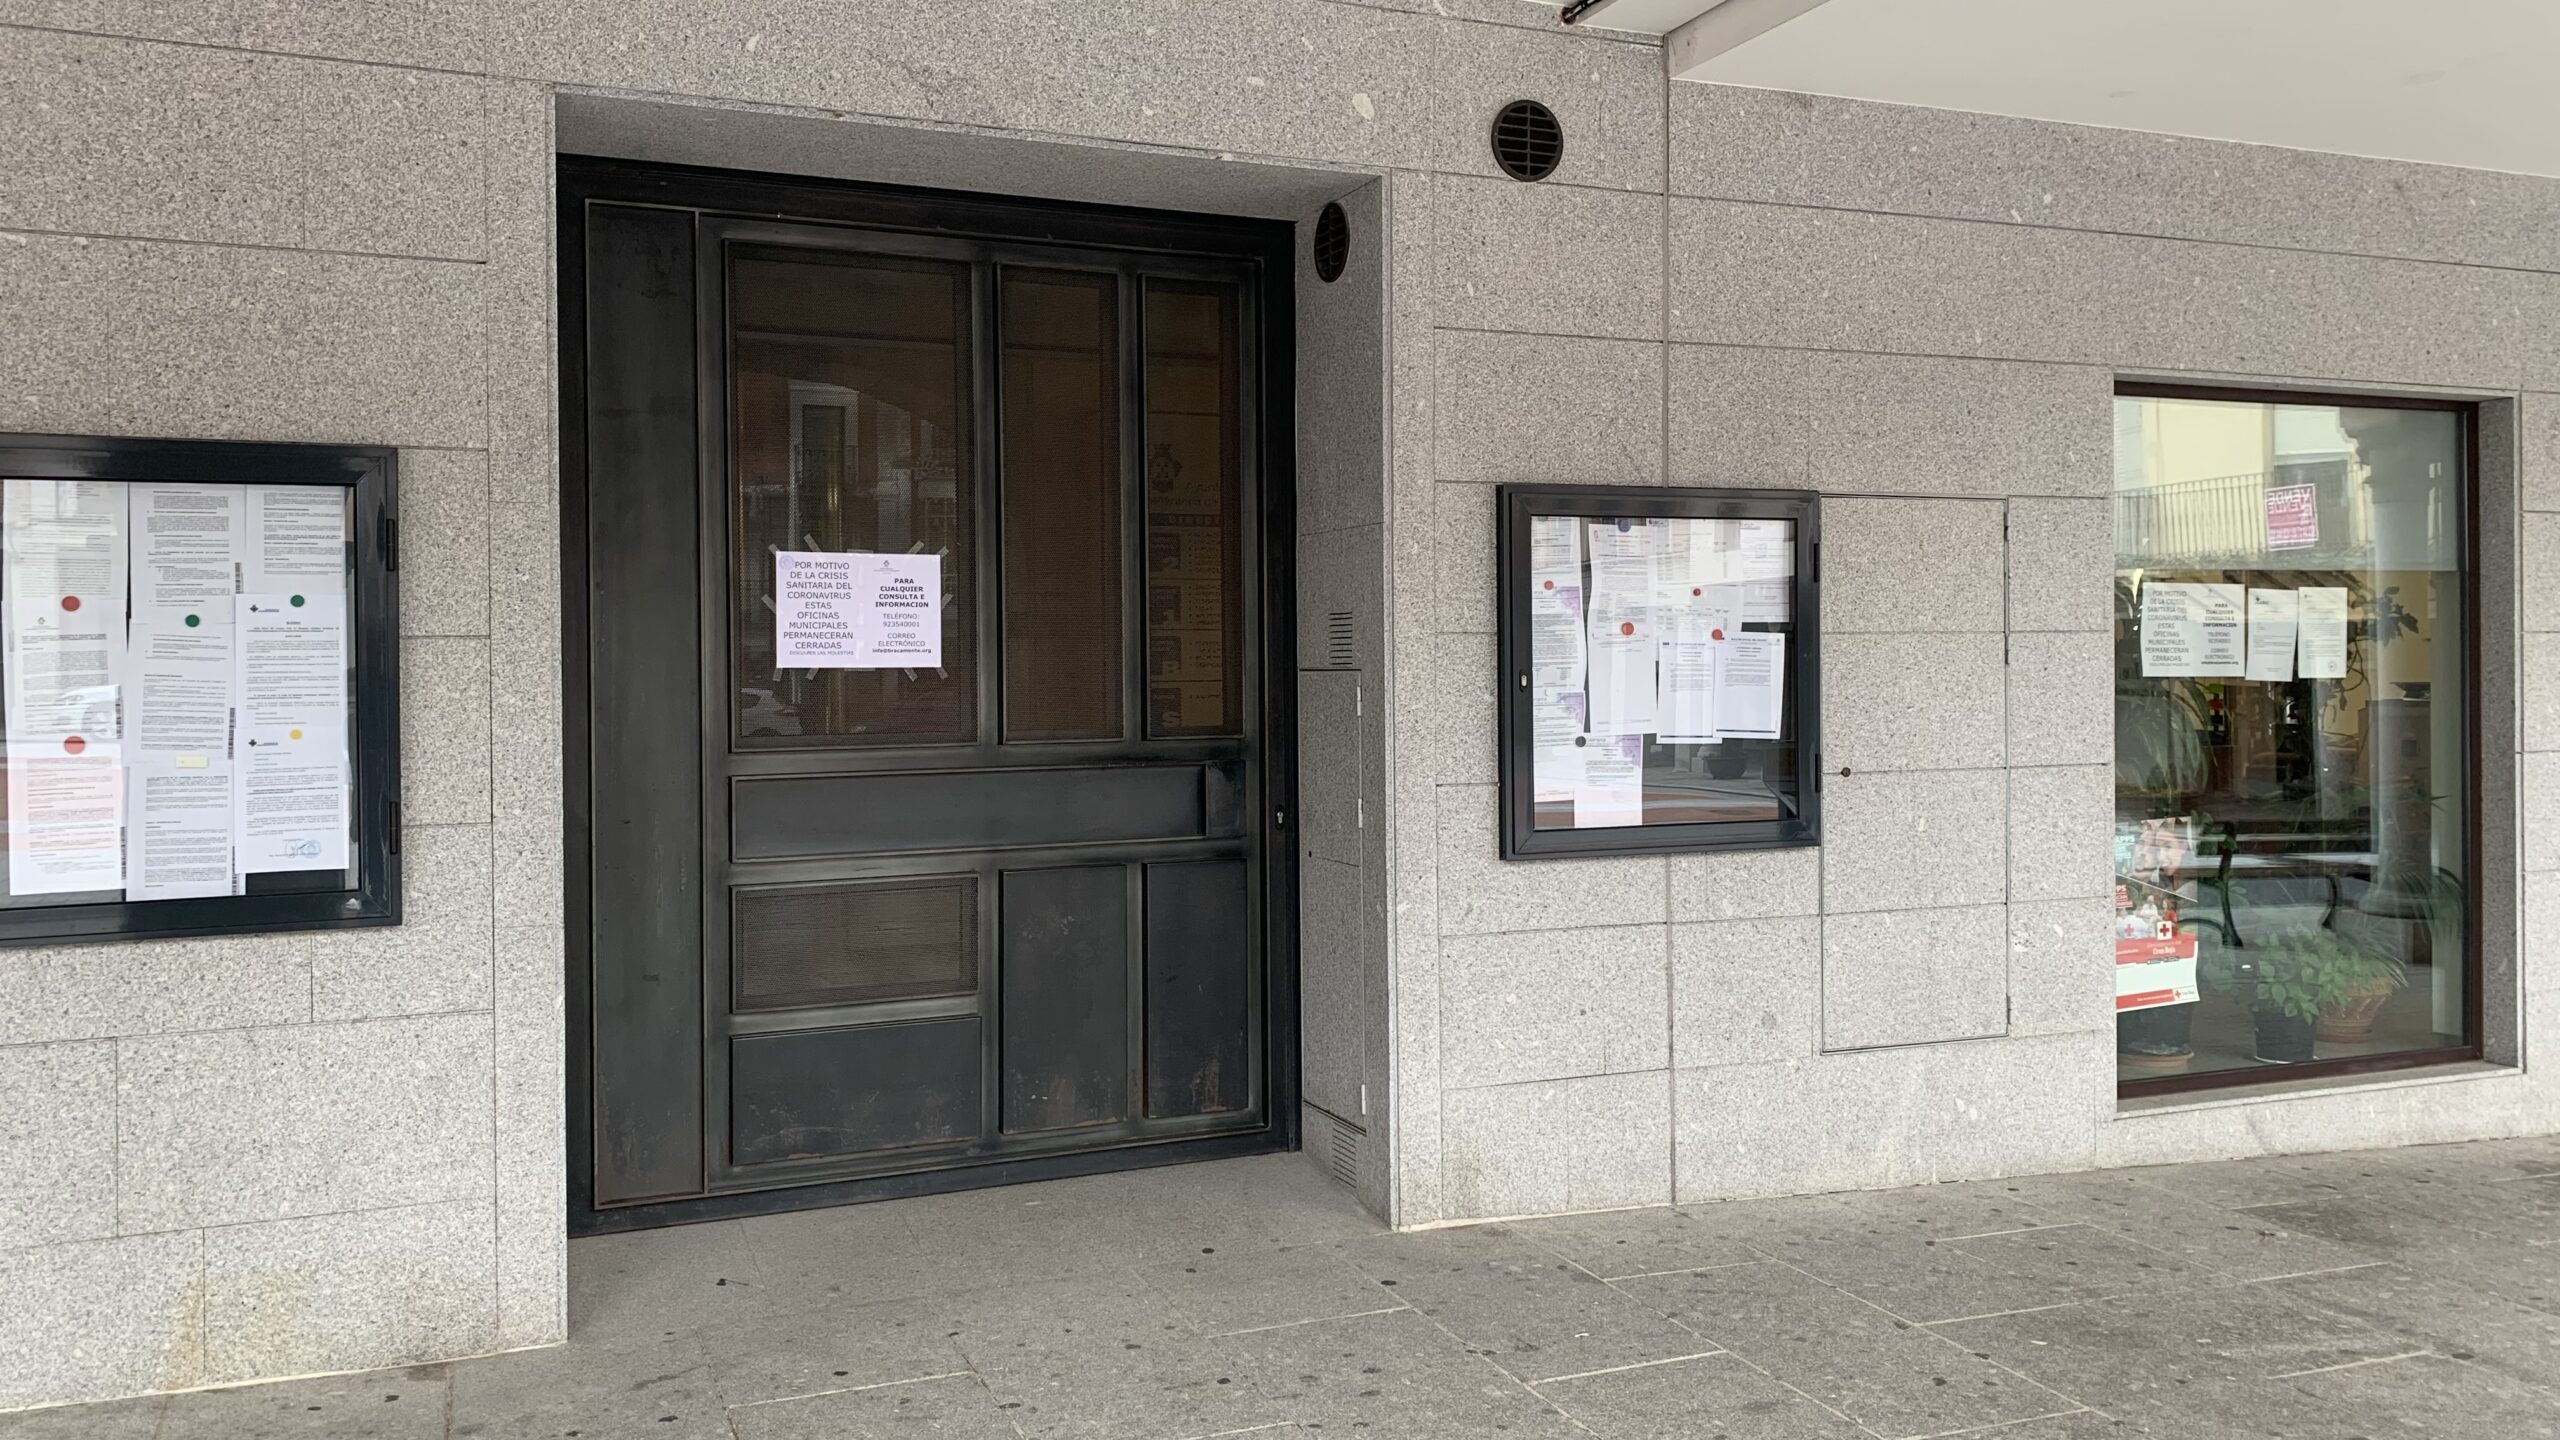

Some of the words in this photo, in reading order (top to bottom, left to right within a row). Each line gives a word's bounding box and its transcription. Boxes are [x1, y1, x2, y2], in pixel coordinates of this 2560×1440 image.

[794, 561, 812, 569] POR
[815, 562, 850, 570] MOTIVO
[790, 571, 802, 579] DE
[818, 572, 849, 580] CRISIS
[786, 581, 833, 589] SANITARIA
[836, 582, 853, 590] DEL
[787, 591, 852, 600] CORONAVIRUS
[797, 611, 840, 620] OFICINAS
[789, 621, 848, 630] MUNICIPALES
[783, 631, 853, 639] PERMANECERAN
